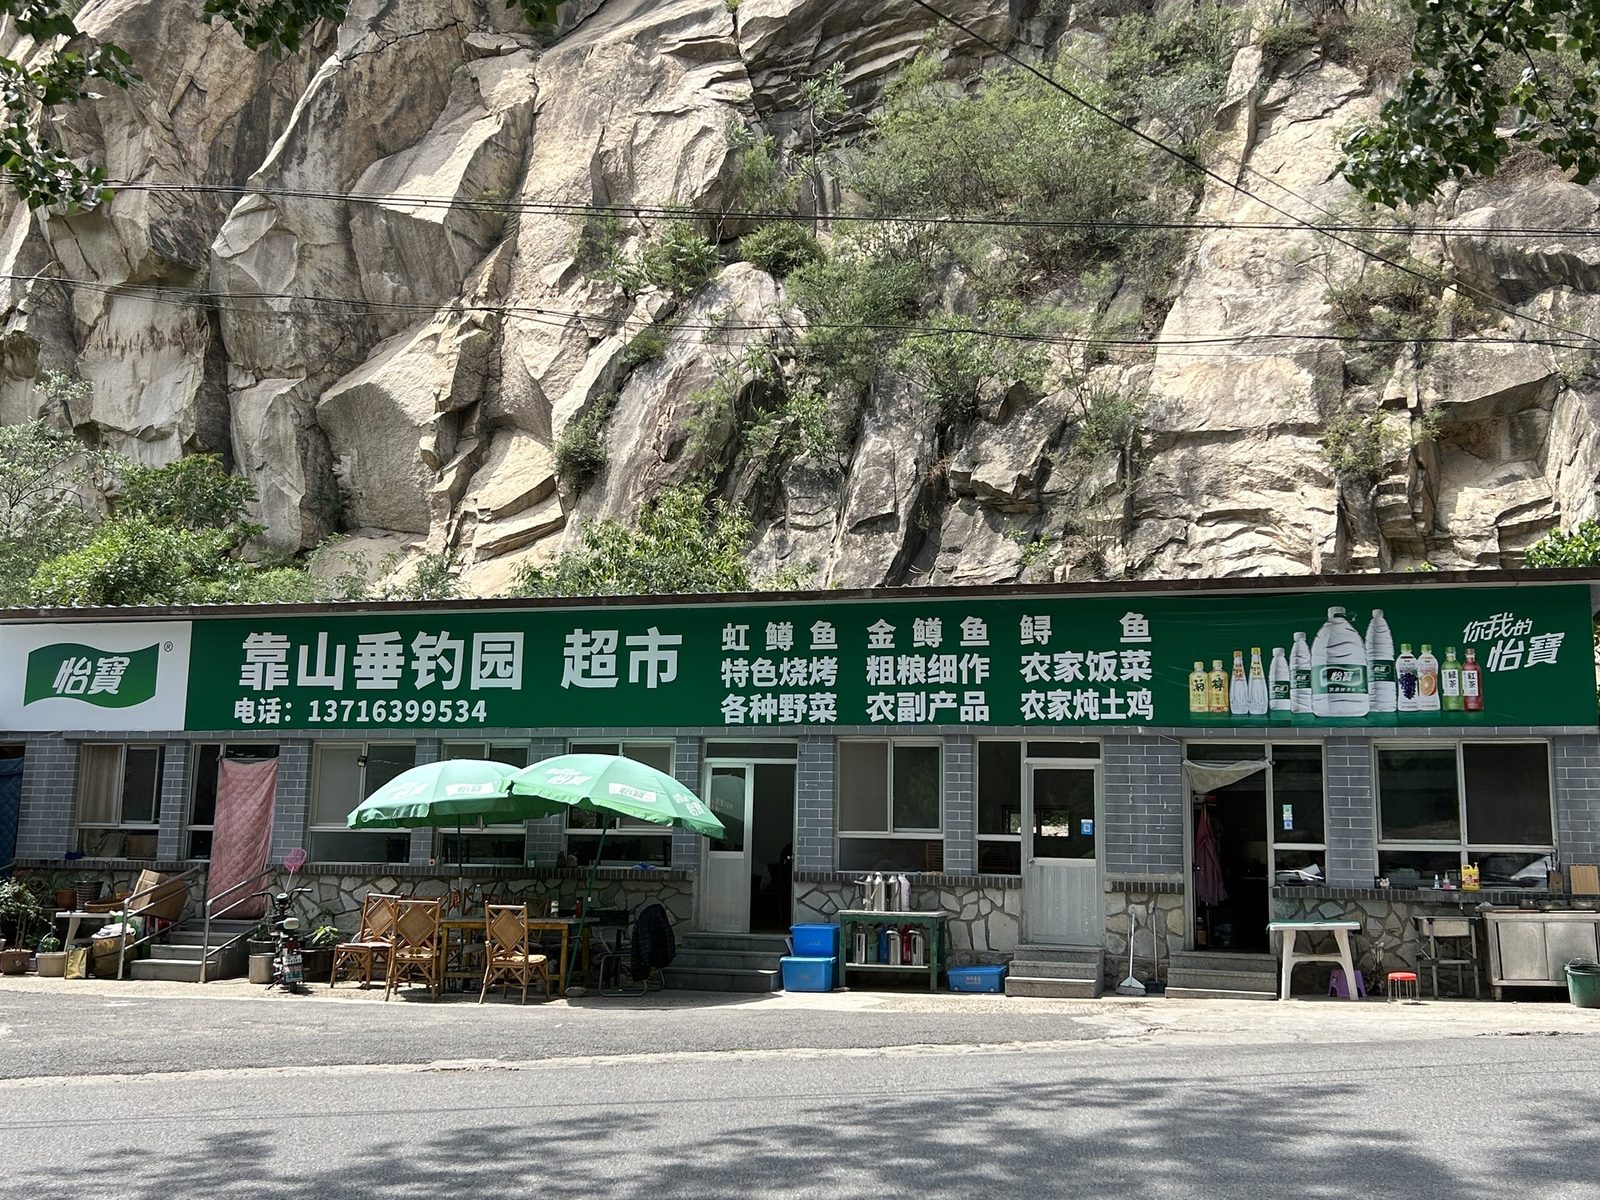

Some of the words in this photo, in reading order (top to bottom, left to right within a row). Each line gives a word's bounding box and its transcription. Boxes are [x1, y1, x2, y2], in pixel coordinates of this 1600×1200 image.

[1463, 612, 1533, 644] 你我的
[239, 631, 524, 691] 靠山垂钓园
[560, 626, 683, 690] 超市
[721, 656, 838, 688] 特色烧烤
[866, 653, 990, 686] 粗粮细作
[1019, 650, 1152, 683] 农家饭菜
[1486, 632, 1565, 672] 怡寶
[52, 656, 131, 695] 怡寶
[720, 691, 838, 724] 各种野菜
[866, 691, 990, 723] 农副产品
[1019, 687, 1154, 722] 农家炖土鸡
